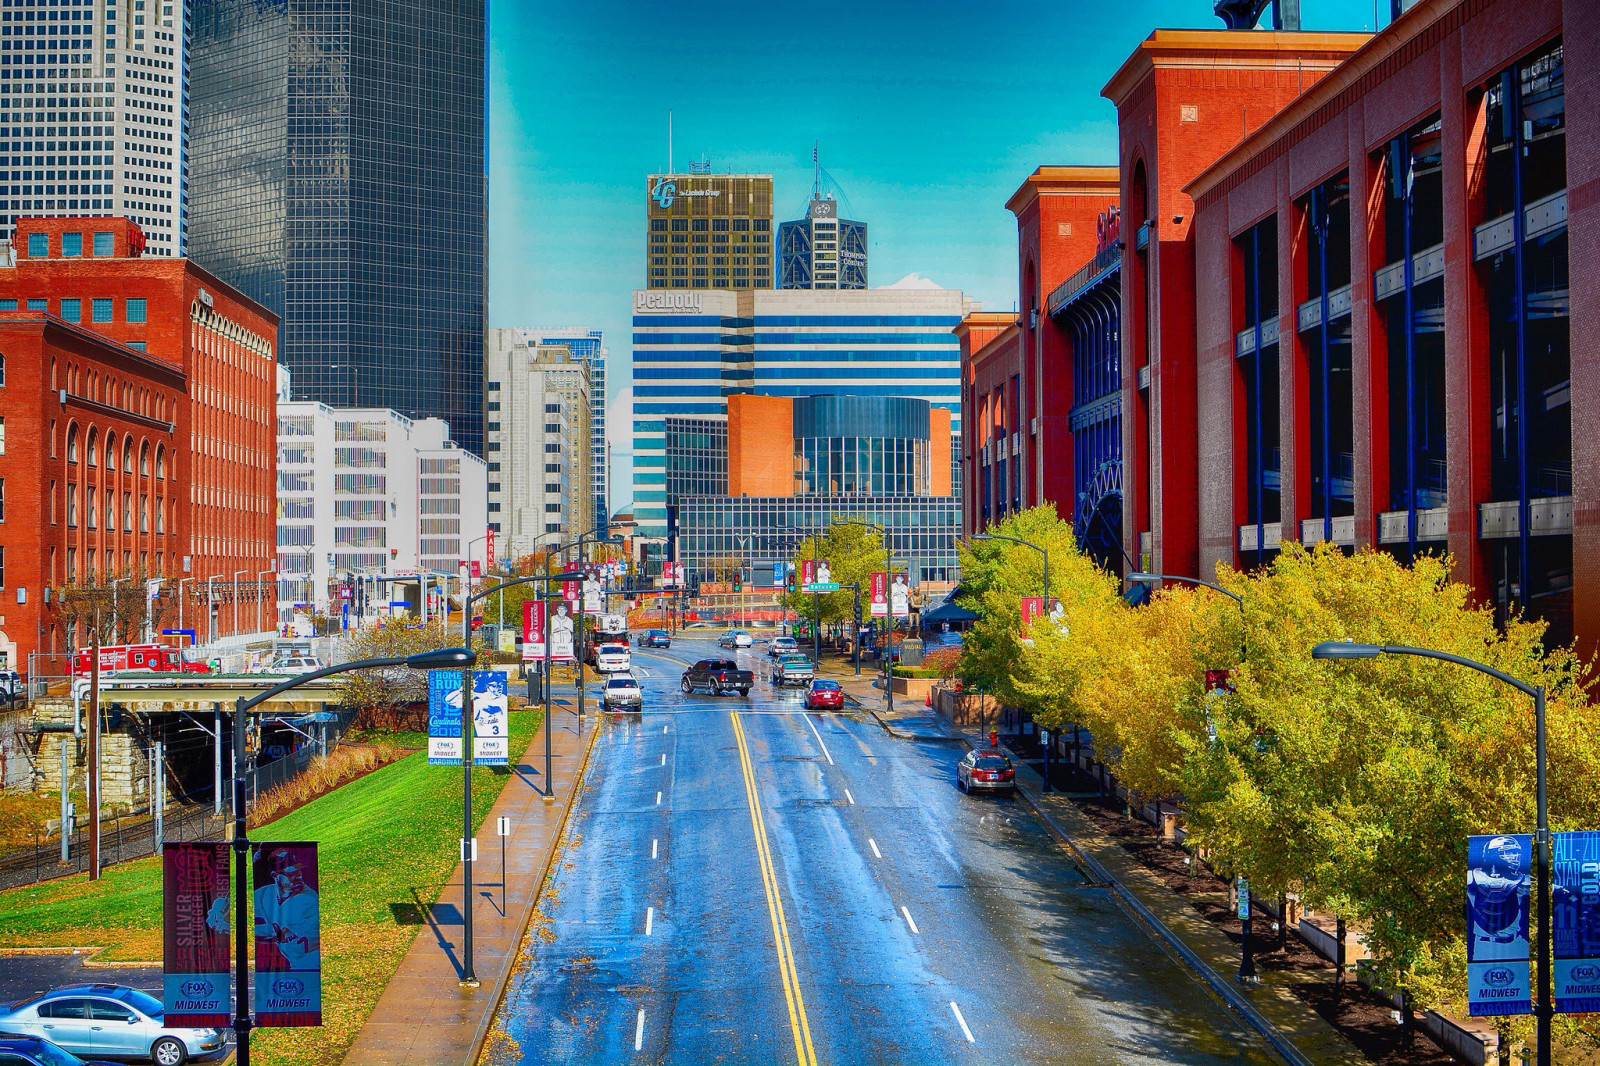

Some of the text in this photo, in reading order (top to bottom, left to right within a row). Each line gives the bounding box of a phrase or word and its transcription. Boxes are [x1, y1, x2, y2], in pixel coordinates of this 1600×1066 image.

[637, 290, 703, 313] Peabody
[435, 671, 462, 680] HOME
[435, 680, 461, 689] RUN
[429, 715, 461, 728] Cardinals
[430, 728, 460, 737] 2013
[492, 725, 499, 735] 3
[1554, 861, 1580, 887] STAR
[1582, 862, 1599, 905] GOLD
[176, 894, 191, 946] SILVER
[192, 894, 204, 946] SLUGGER
[1554, 902, 1576, 929] 11
[176, 948, 229, 960] BUSCH
[176, 960, 229, 970] STADIUM
[1490, 970, 1508, 980] FOX
[1576, 967, 1594, 977] FOX
[187, 982, 207, 991] FOX
[278, 982, 298, 991] FOX
[1478, 987, 1521, 998] MIDWEST
[174, 1000, 220, 1010] MIDWEST
[266, 998, 311, 1009] MIDWEST
[1471, 1000, 1531, 1016] CARDINAL
[164, 1014, 227, 1027] CARDINAL
[263, 1013, 315, 1026] NATION
